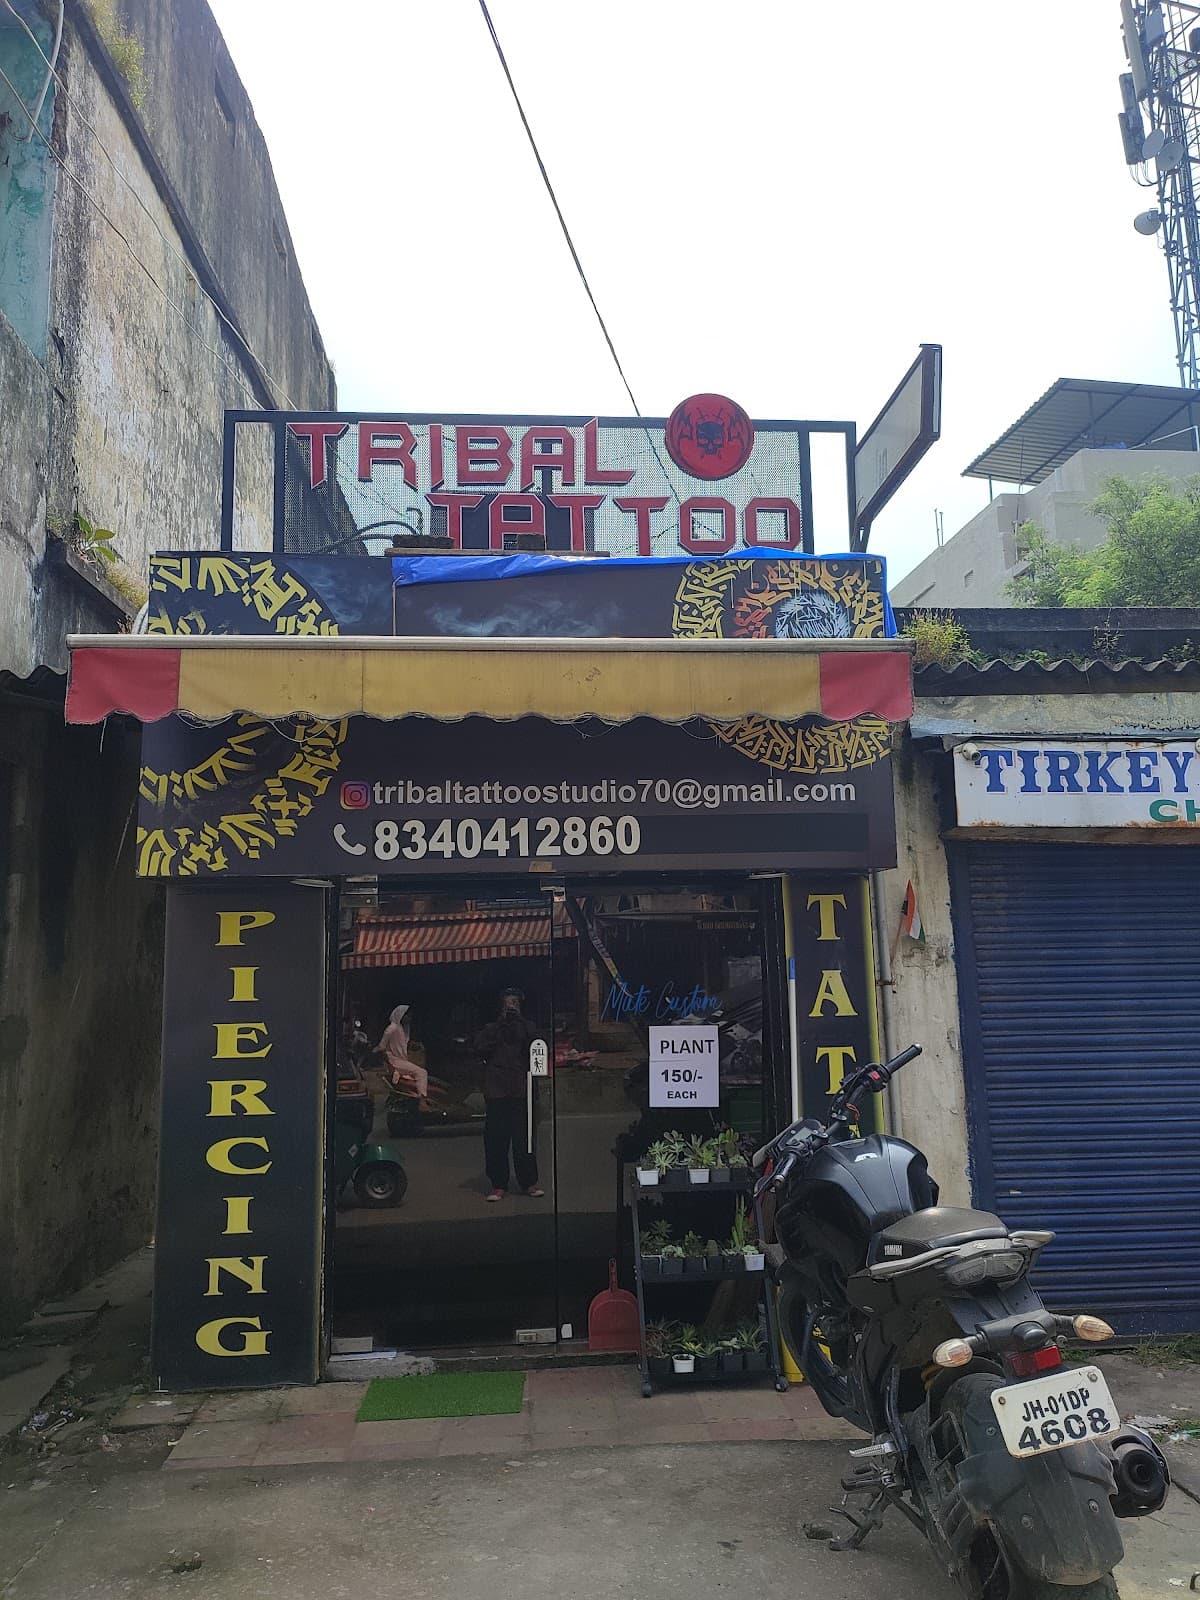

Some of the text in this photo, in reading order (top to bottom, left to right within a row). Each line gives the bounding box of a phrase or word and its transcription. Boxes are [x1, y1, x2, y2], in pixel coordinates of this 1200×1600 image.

[287, 417, 636, 490] TRIBAL
[425, 493, 801, 556] TATTOO
[974, 750, 1194, 793] TIRKEY
[373, 778, 856, 809] tribaltattoostudio70@gmail.com
[374, 815, 641, 860] 8340412860
[656, 981, 722, 1019] Custom
[806, 894, 858, 1139] TAT
[532, 1048, 544, 1056] PULL
[660, 1039, 715, 1054] PLANT
[661, 1069, 703, 1083] 150/-
[667, 1090, 697, 1100] EACH
[195, 911, 277, 1357] PIERCING
[1018, 1408, 1111, 1451] 4608
